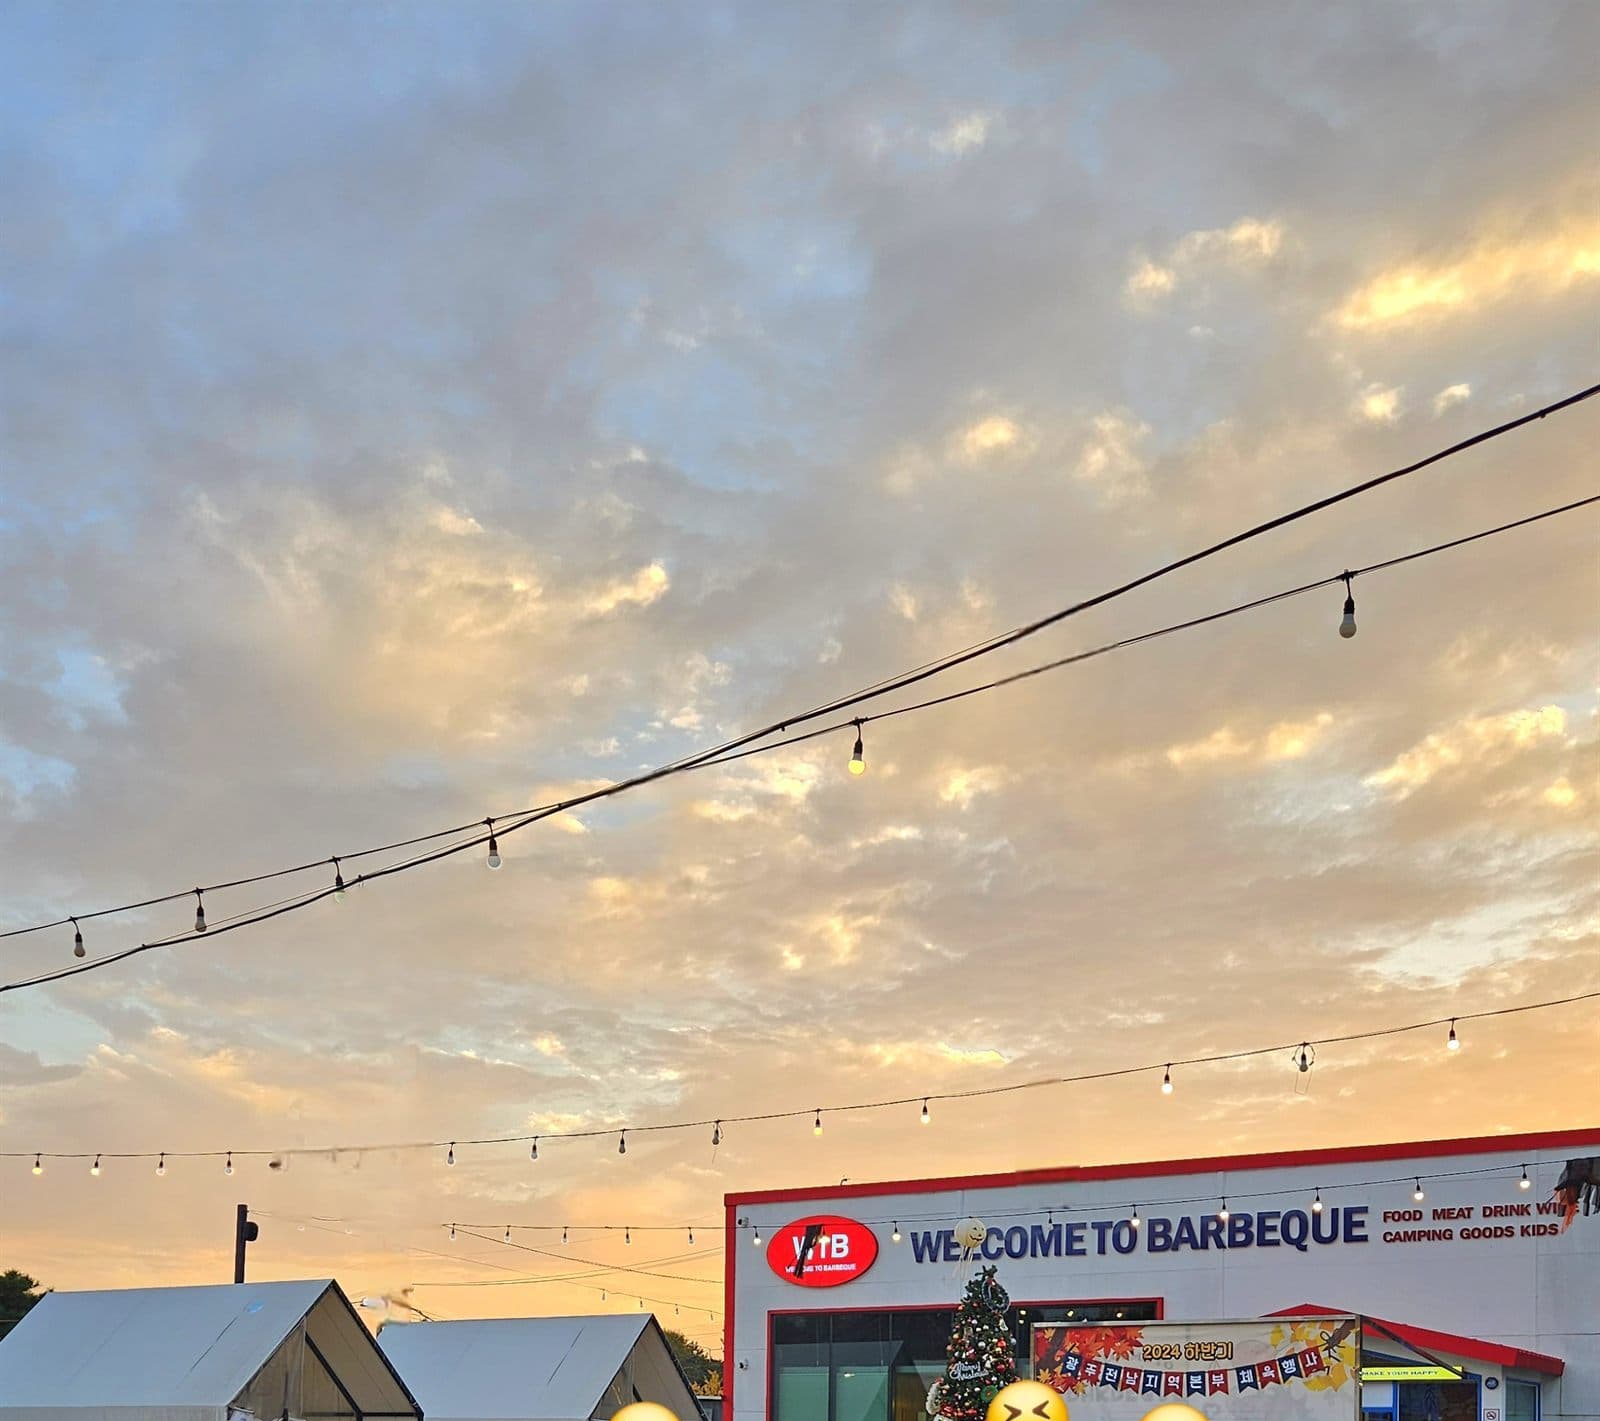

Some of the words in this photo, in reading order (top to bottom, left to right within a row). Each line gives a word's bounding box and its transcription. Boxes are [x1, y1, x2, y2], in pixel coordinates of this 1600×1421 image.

[1383, 1210, 1423, 1224] FOOD
[1432, 1207, 1475, 1221] MEAT
[1482, 1204, 1531, 1218] DRINK
[1147, 1206, 1369, 1252] BARBEQUE
[1383, 1229, 1453, 1243] CAMPING
[1460, 1226, 1515, 1240] GOODS
[1520, 1223, 1559, 1237] KIDS
[1143, 1344, 1182, 1360] 2024
[1184, 1341, 1234, 1361] 하반기
